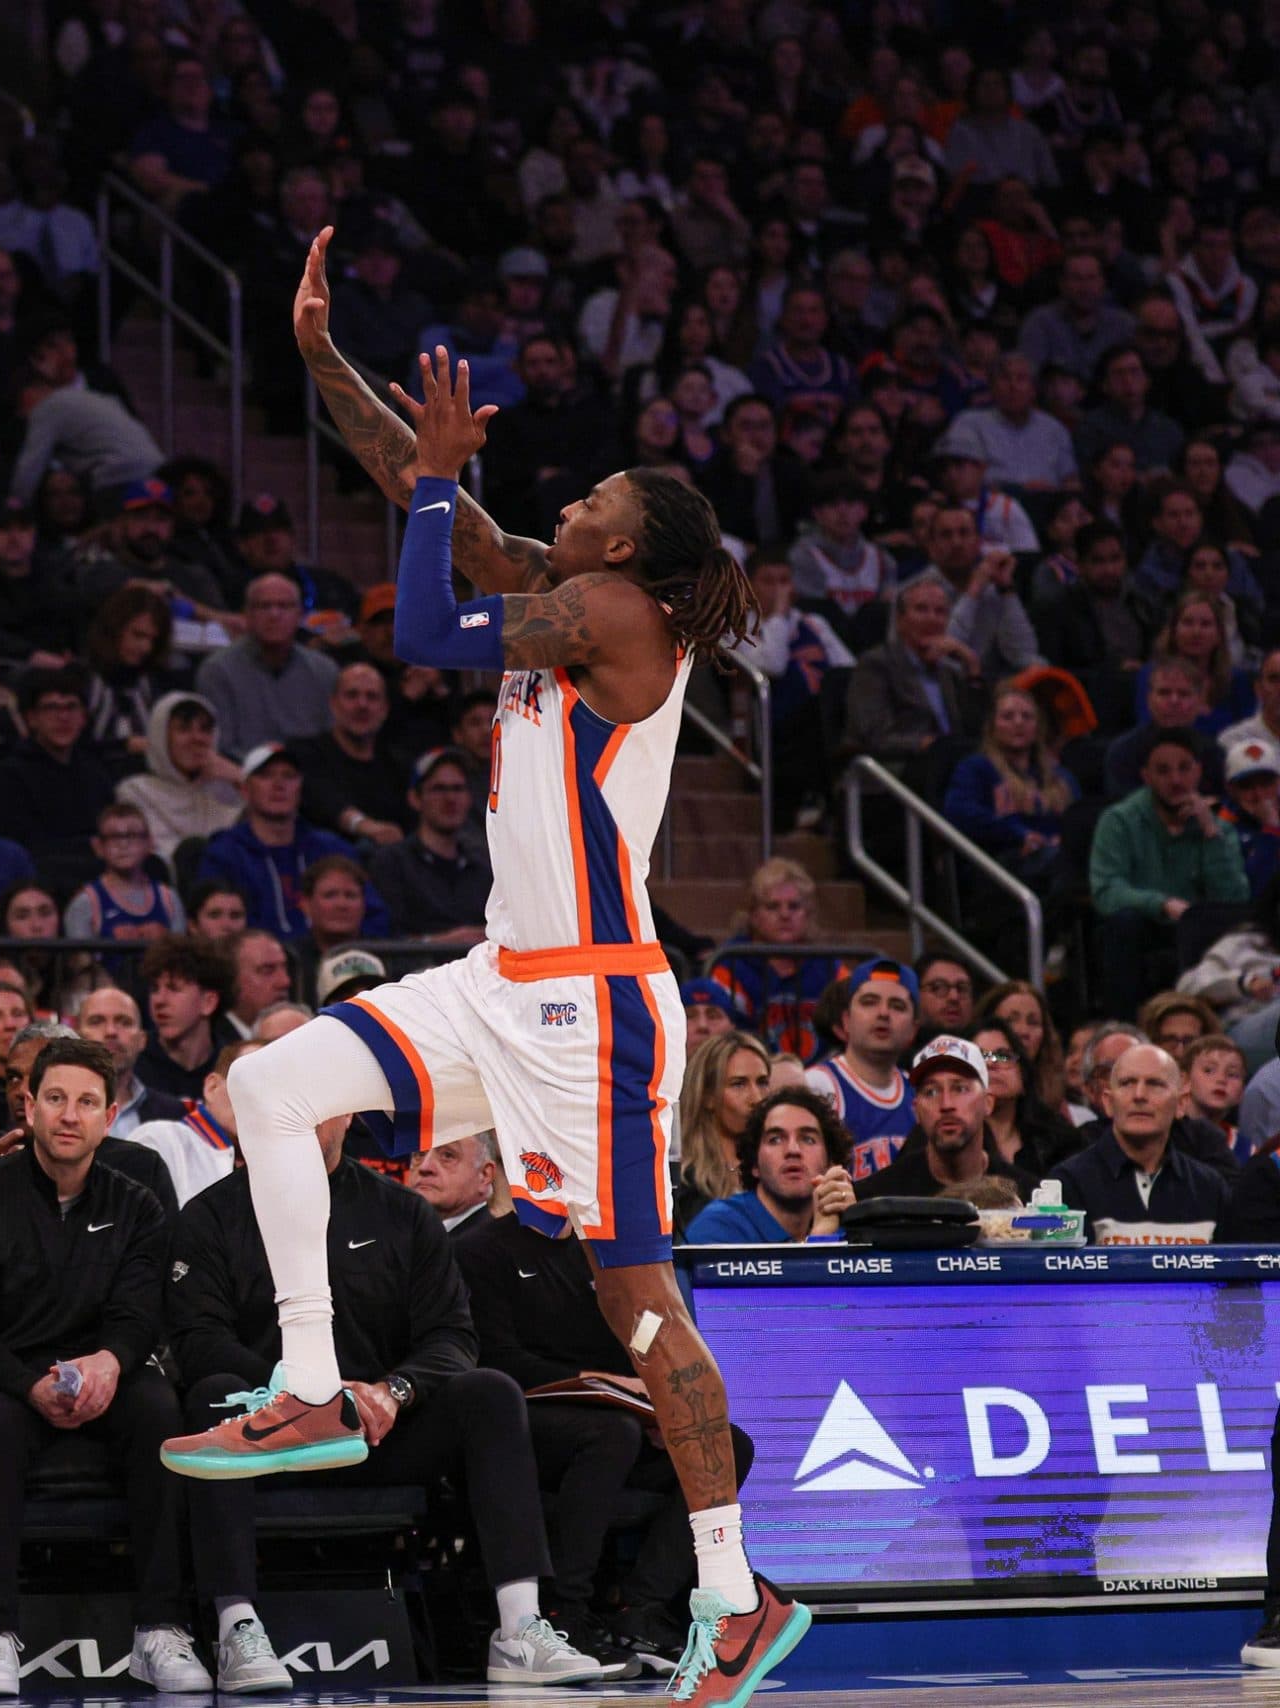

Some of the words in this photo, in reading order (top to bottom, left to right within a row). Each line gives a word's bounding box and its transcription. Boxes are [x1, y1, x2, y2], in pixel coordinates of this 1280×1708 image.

[540, 1002, 577, 1026] NYC
[717, 1259, 783, 1276] CHASE
[827, 1258, 893, 1274] CHASE
[937, 1256, 1001, 1272] CHASE
[1045, 1255, 1109, 1270] CHASE
[1152, 1254, 1215, 1269] CHASE
[963, 1382, 1280, 1478] DEL
[1103, 1578, 1218, 1592] DAKTRONICS
